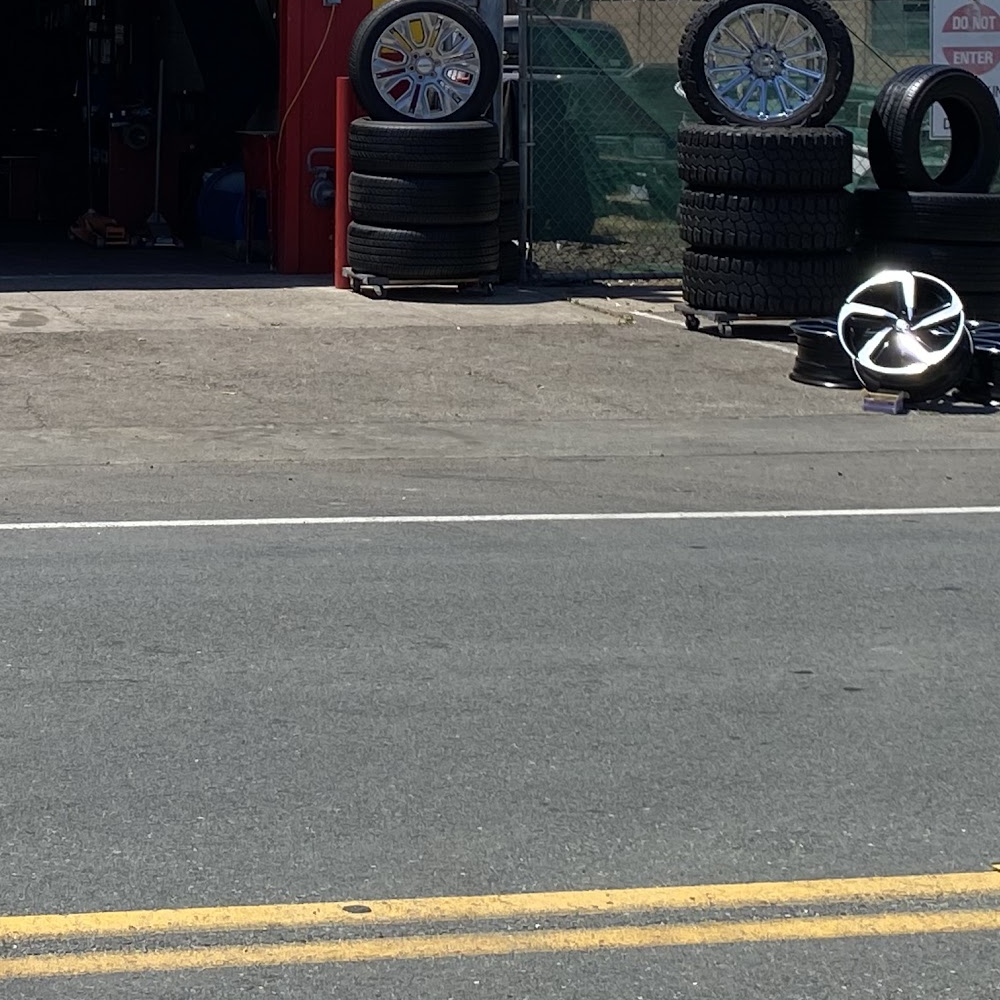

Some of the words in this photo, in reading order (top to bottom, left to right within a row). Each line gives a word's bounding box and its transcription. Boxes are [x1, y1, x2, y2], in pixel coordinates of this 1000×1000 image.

[952, 16, 969, 30] DO
[972, 15, 997, 30] NOT
[953, 51, 994, 65] ENTER
